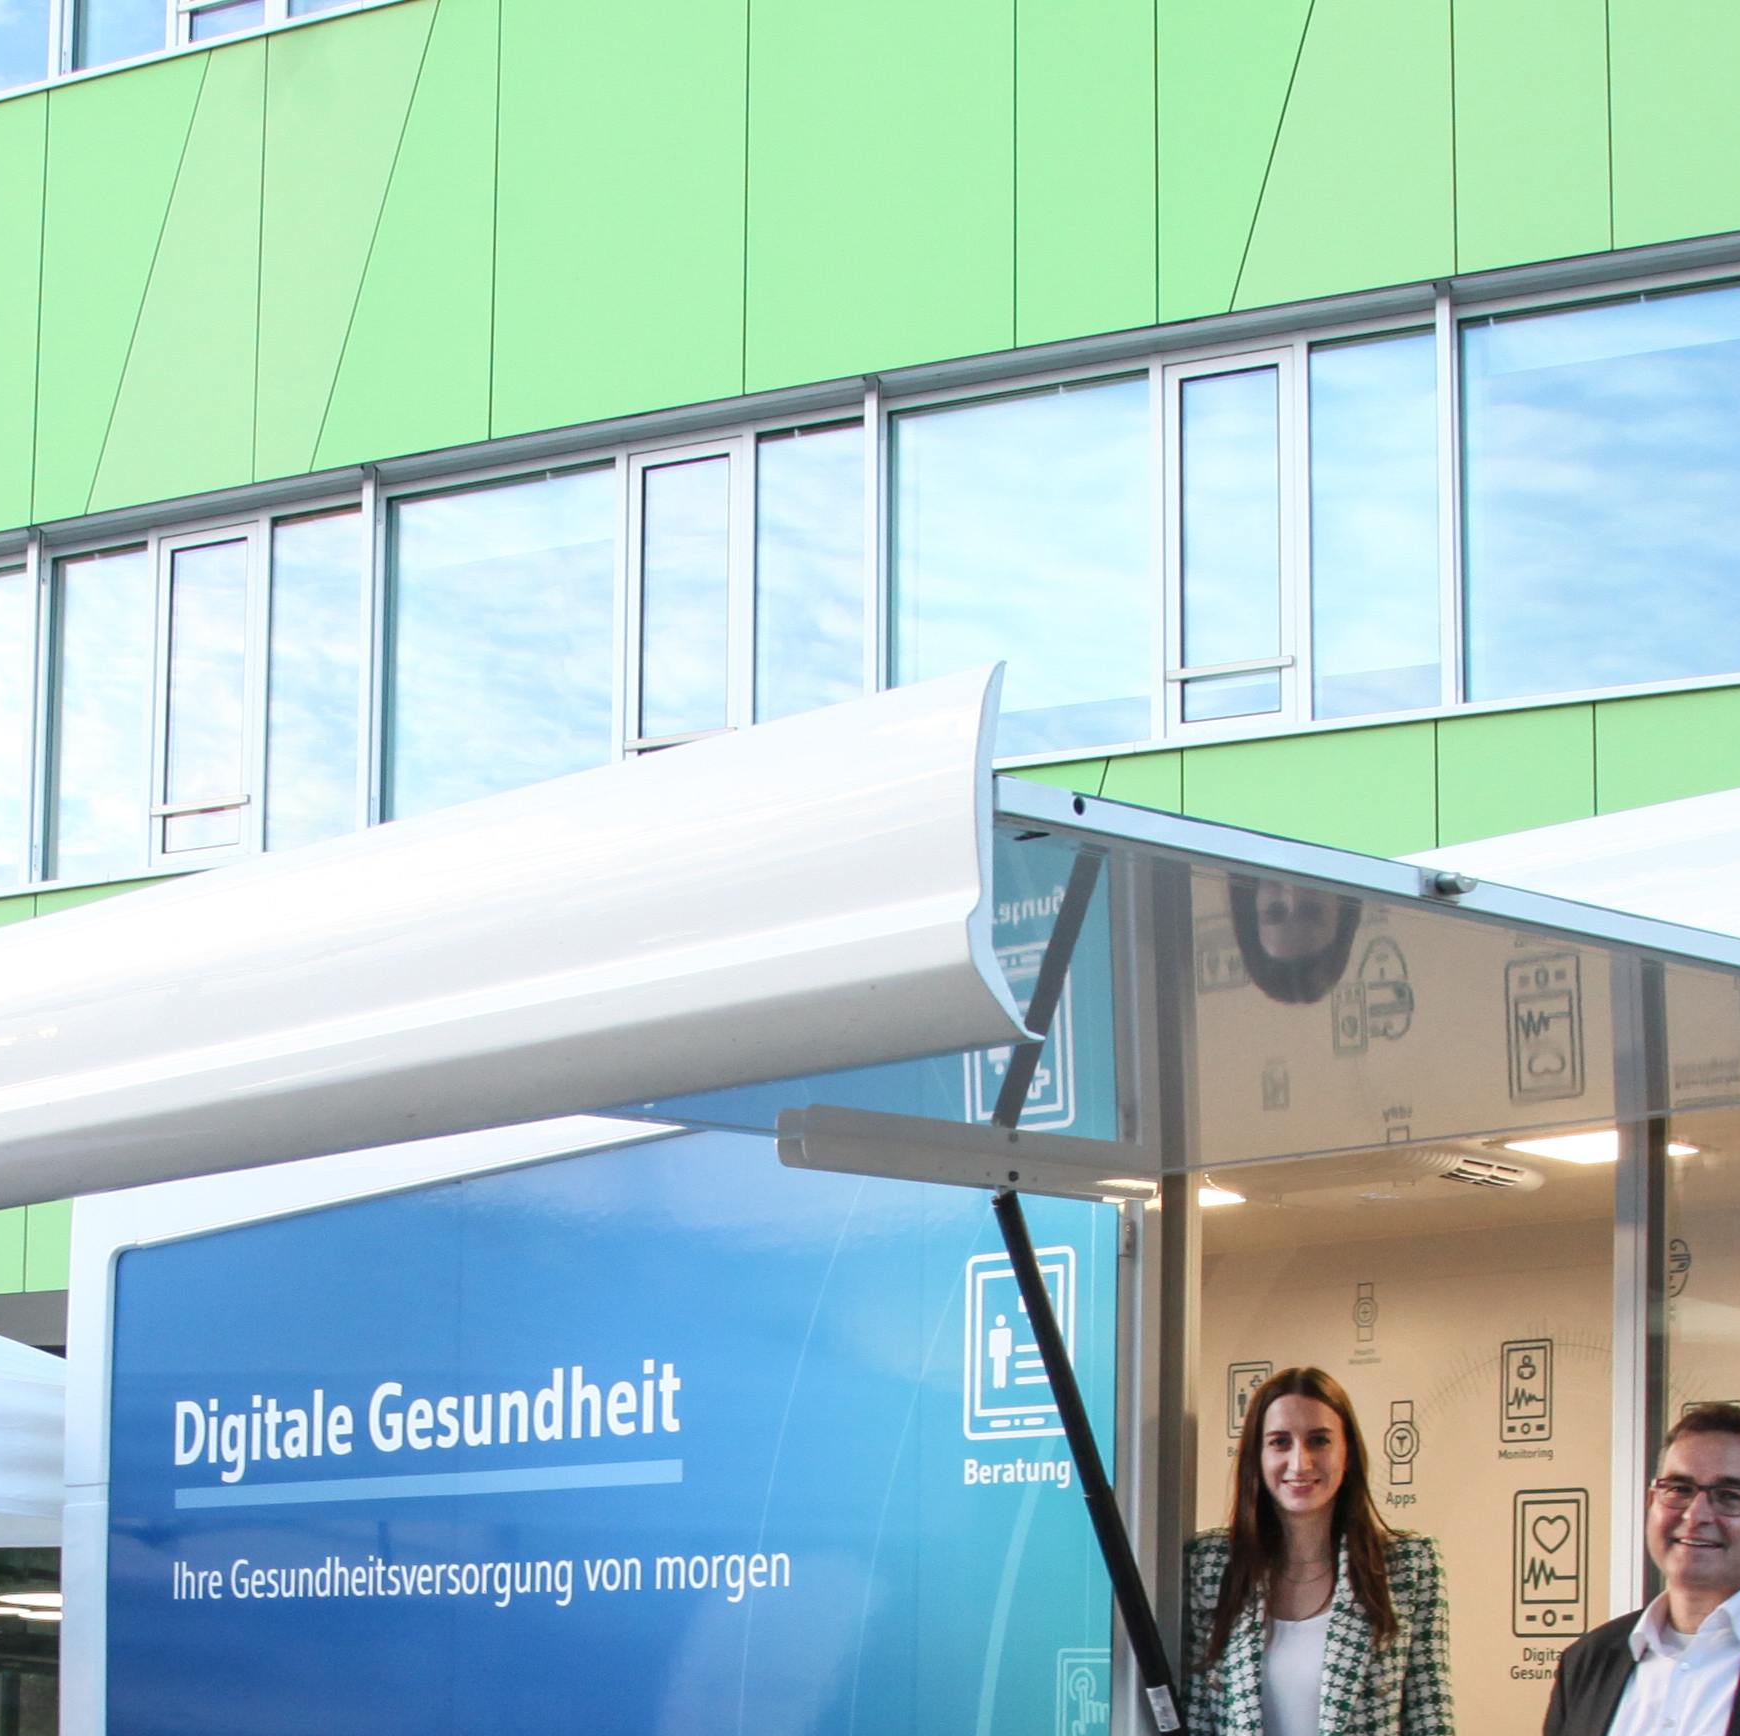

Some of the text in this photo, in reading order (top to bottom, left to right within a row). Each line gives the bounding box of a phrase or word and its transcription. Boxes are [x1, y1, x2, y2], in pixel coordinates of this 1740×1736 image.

[174, 1358, 683, 1483] Digitale Gesundheit
[1498, 1447, 1554, 1462] Monitoring
[963, 1458, 1072, 1490] Beratung
[1386, 1491, 1417, 1507] Apps
[172, 1551, 791, 1608] Ihre Gesundheitsversorgung von morgen
[1523, 1647, 1563, 1666] Digita
[1510, 1665, 1557, 1680] Gesun
